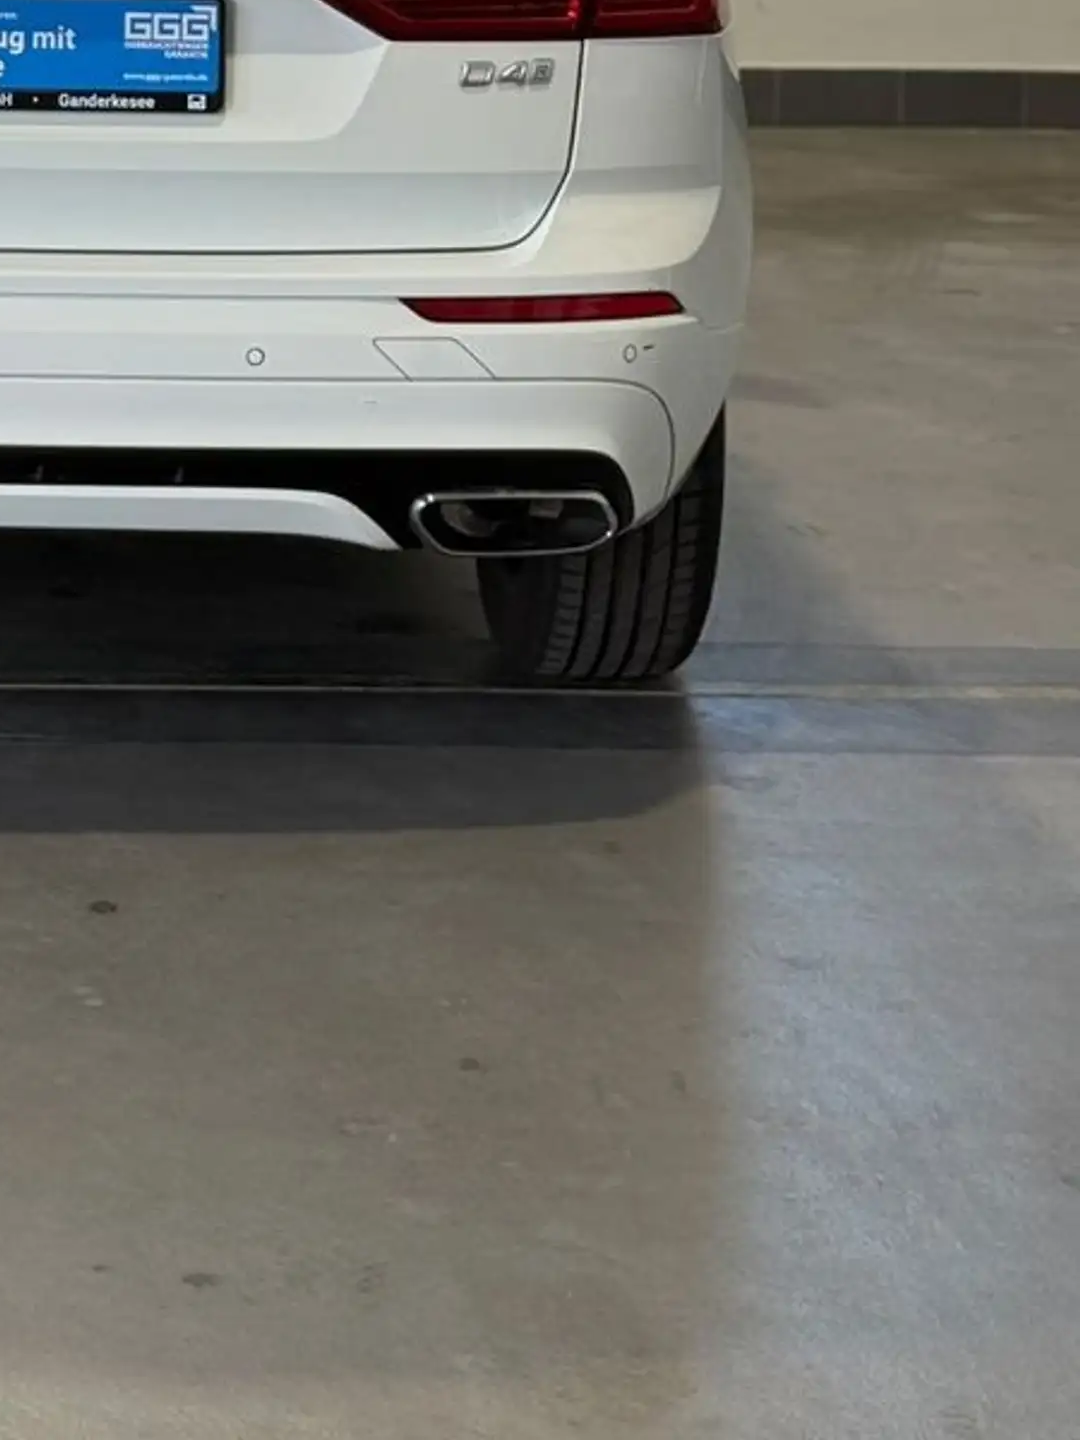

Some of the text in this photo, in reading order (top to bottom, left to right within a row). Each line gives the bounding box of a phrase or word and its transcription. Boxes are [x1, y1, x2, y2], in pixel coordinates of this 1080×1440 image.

[32, 26, 77, 50] mit
[124, 11, 210, 41] GGG
[58, 92, 157, 109] Ganderkesee
